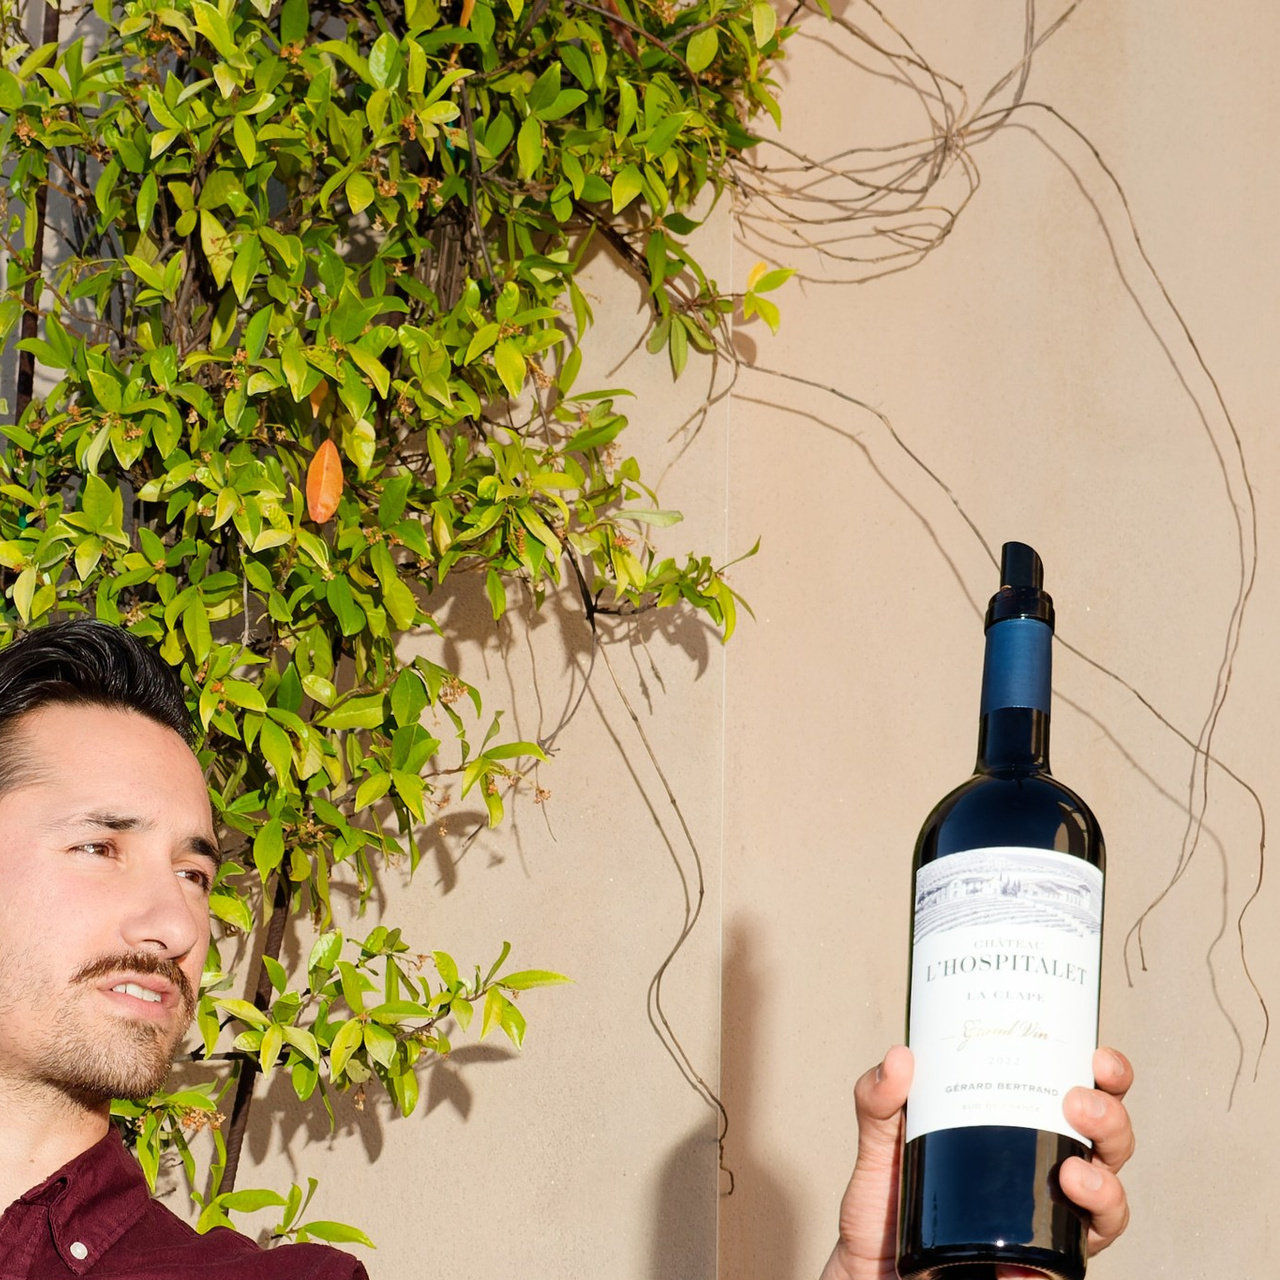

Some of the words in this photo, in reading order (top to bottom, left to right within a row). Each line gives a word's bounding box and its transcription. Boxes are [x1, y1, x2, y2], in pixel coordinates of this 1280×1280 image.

[973, 936, 1045, 950] CHÂTEAU
[926, 953, 1088, 986] L'HOSPITALET
[966, 990, 986, 1001] LA
[993, 990, 1046, 1002] CLAPE
[1018, 1020, 1049, 1040] Vin
[945, 1082, 993, 1094] GÉRARD
[997, 1082, 1059, 1097] BERTRAND
